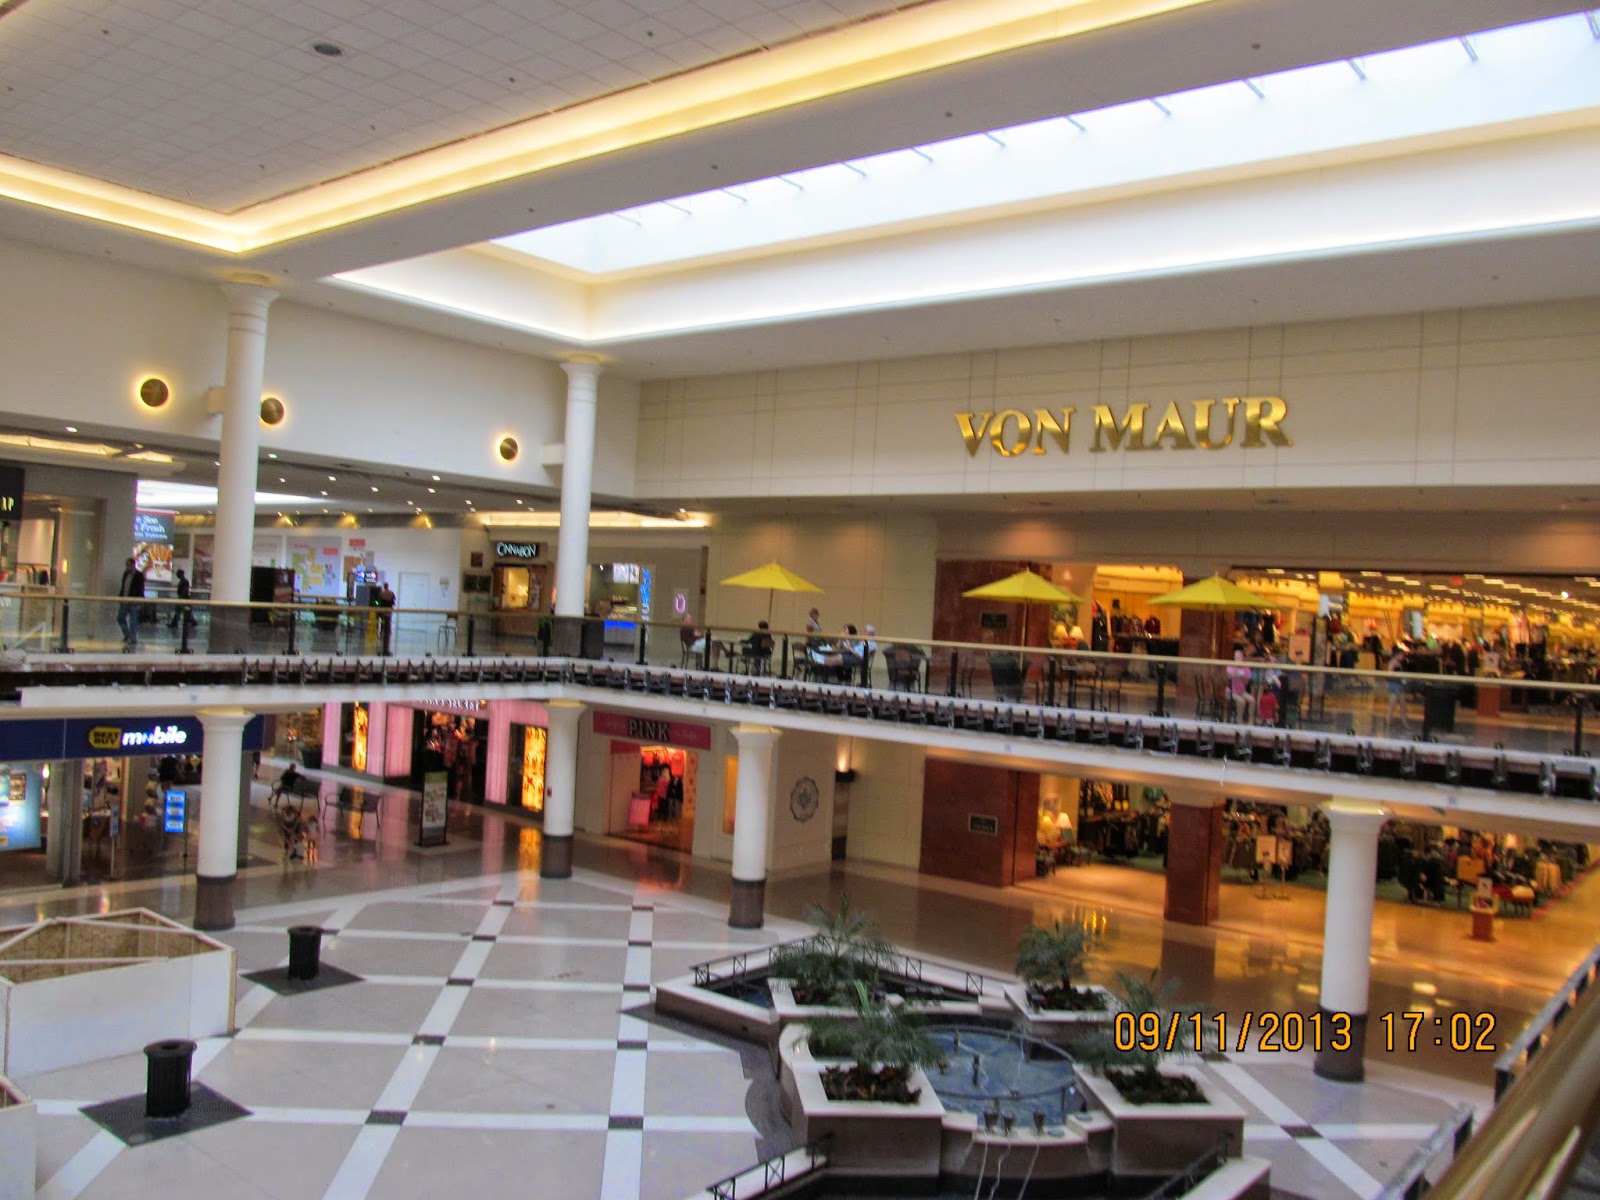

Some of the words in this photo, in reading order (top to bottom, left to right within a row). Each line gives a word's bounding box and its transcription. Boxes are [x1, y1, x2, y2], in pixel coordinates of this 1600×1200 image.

[953, 405, 1076, 458] VON
[1089, 395, 1293, 452] MAUR
[94, 731, 119, 739] BEST
[122, 725, 187, 746] mobile
[628, 718, 670, 742] PINK
